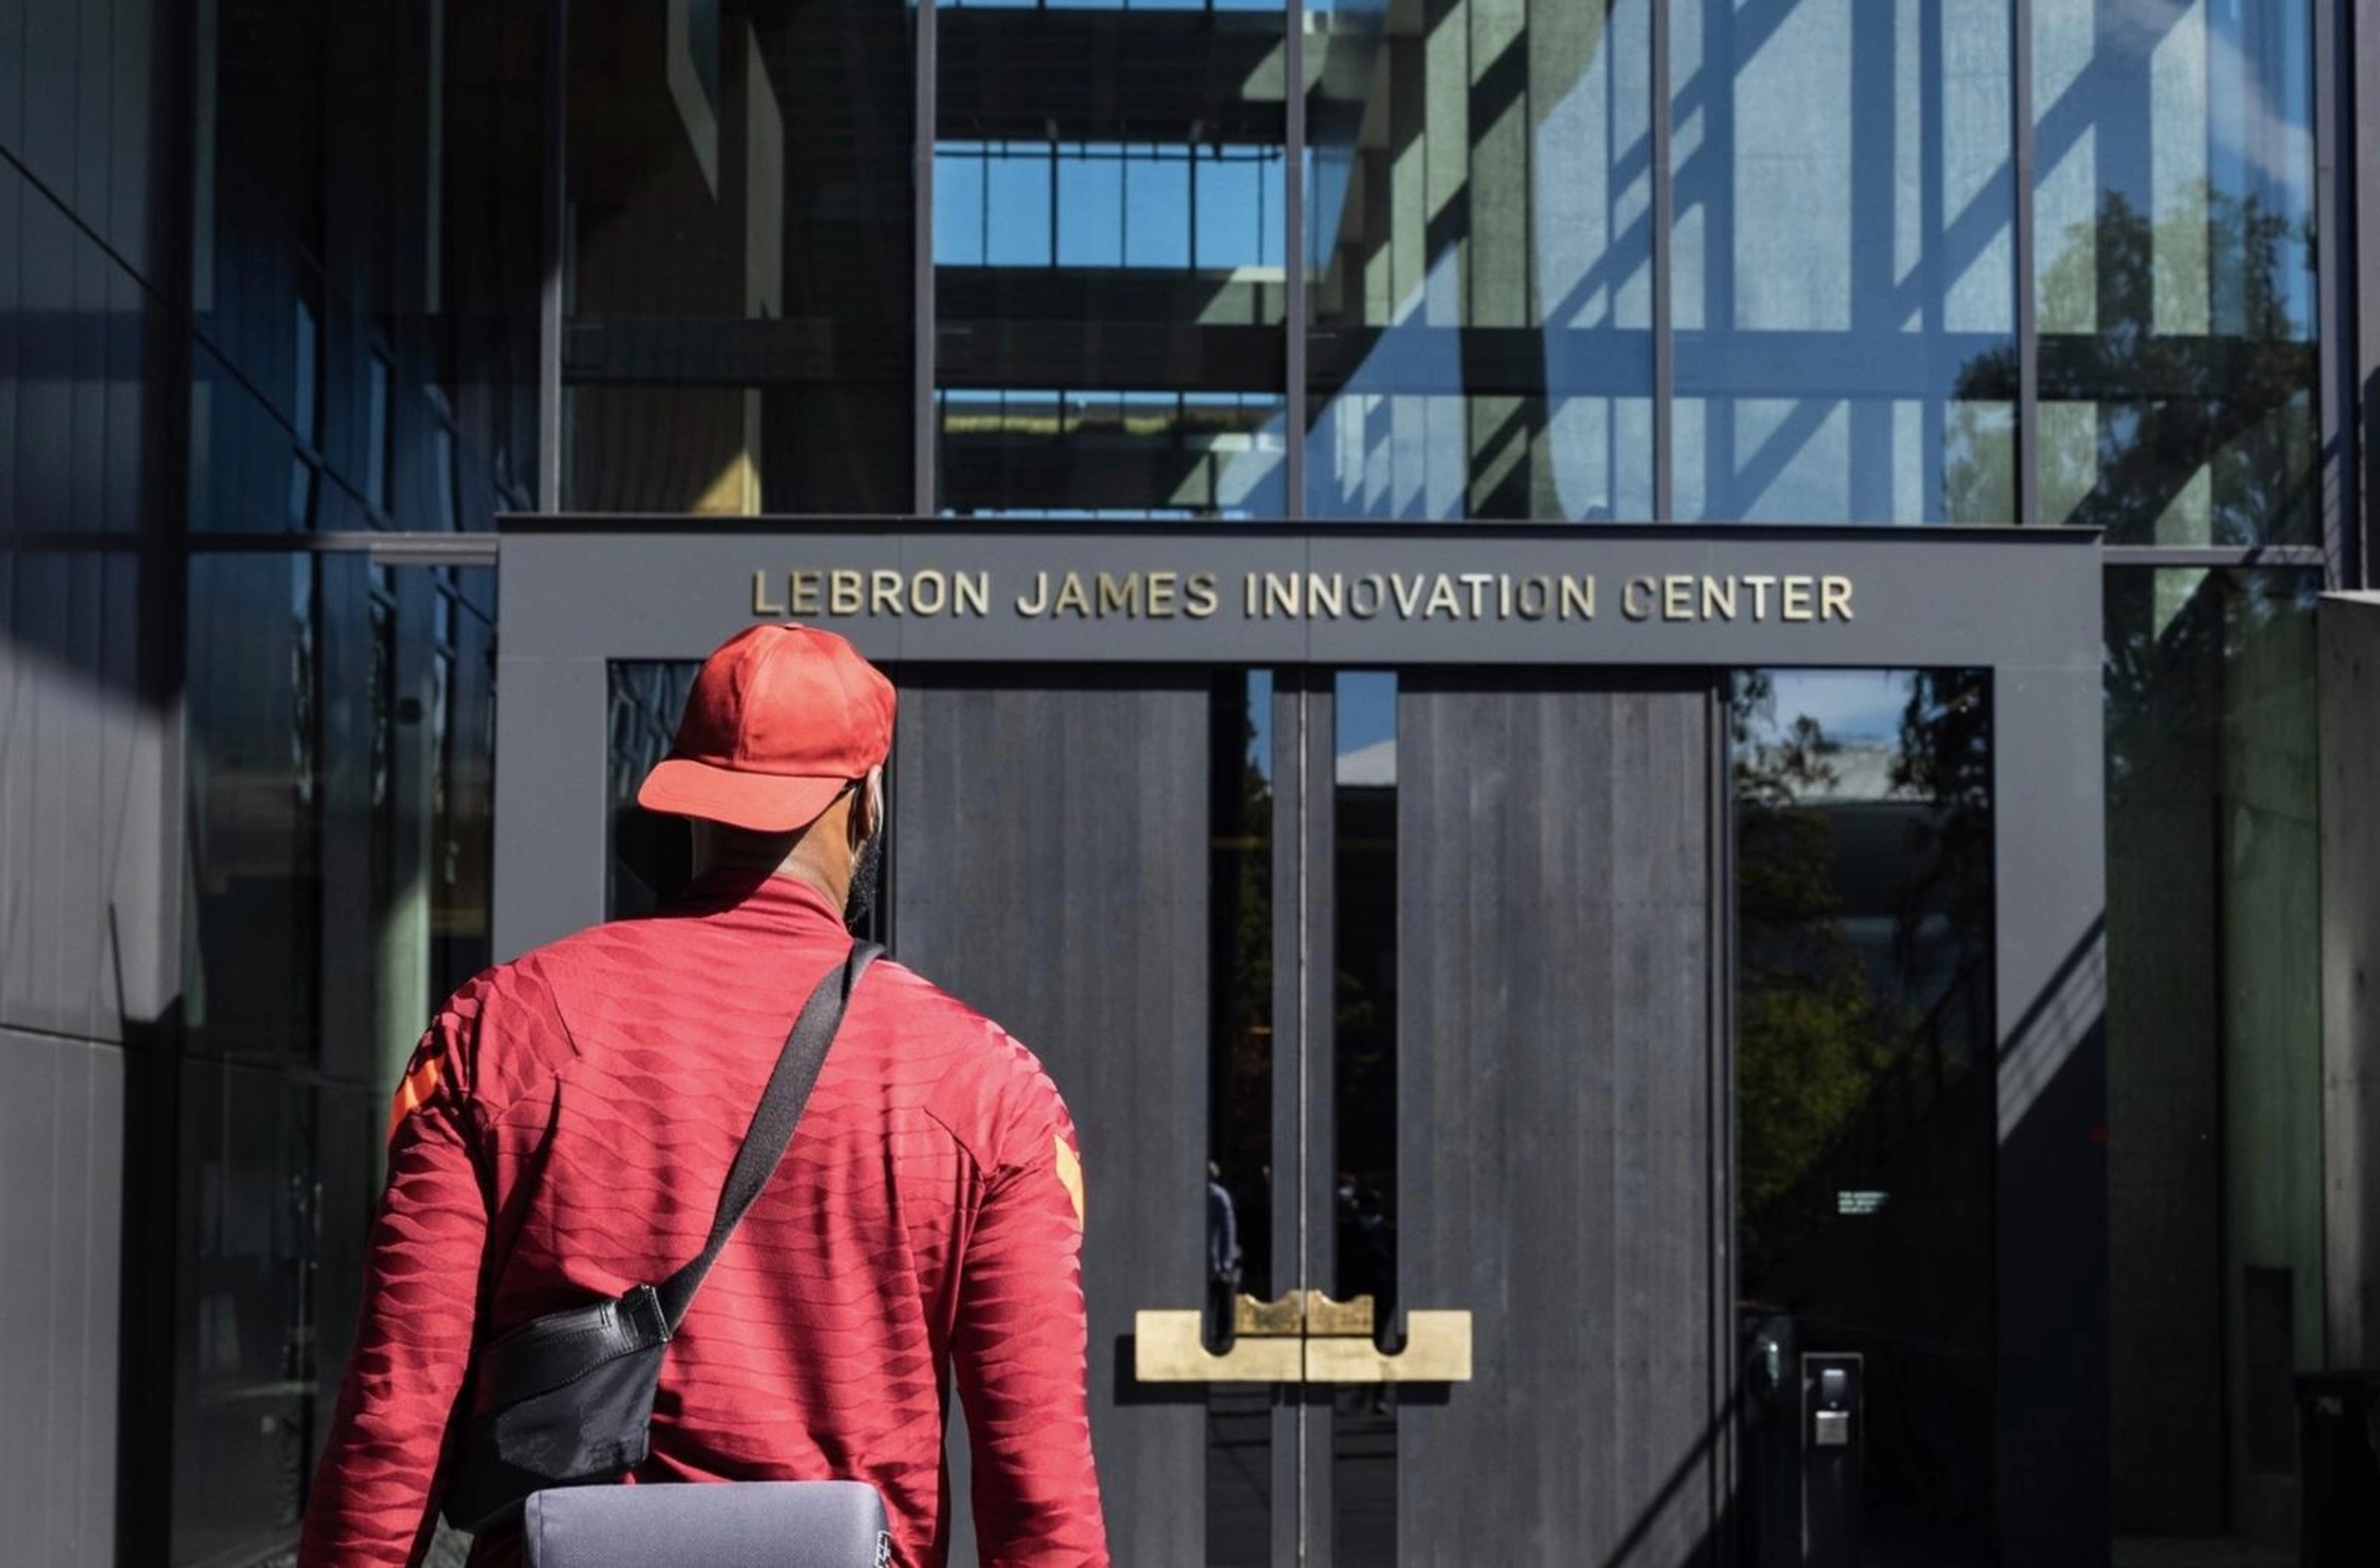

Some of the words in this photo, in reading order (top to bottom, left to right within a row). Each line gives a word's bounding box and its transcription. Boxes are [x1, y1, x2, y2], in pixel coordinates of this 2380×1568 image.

[752, 570, 989, 614] LEBRON
[1017, 571, 1219, 617] JAMES
[1244, 572, 1595, 619] INNOVATION
[1622, 575, 1854, 620] CENTER
